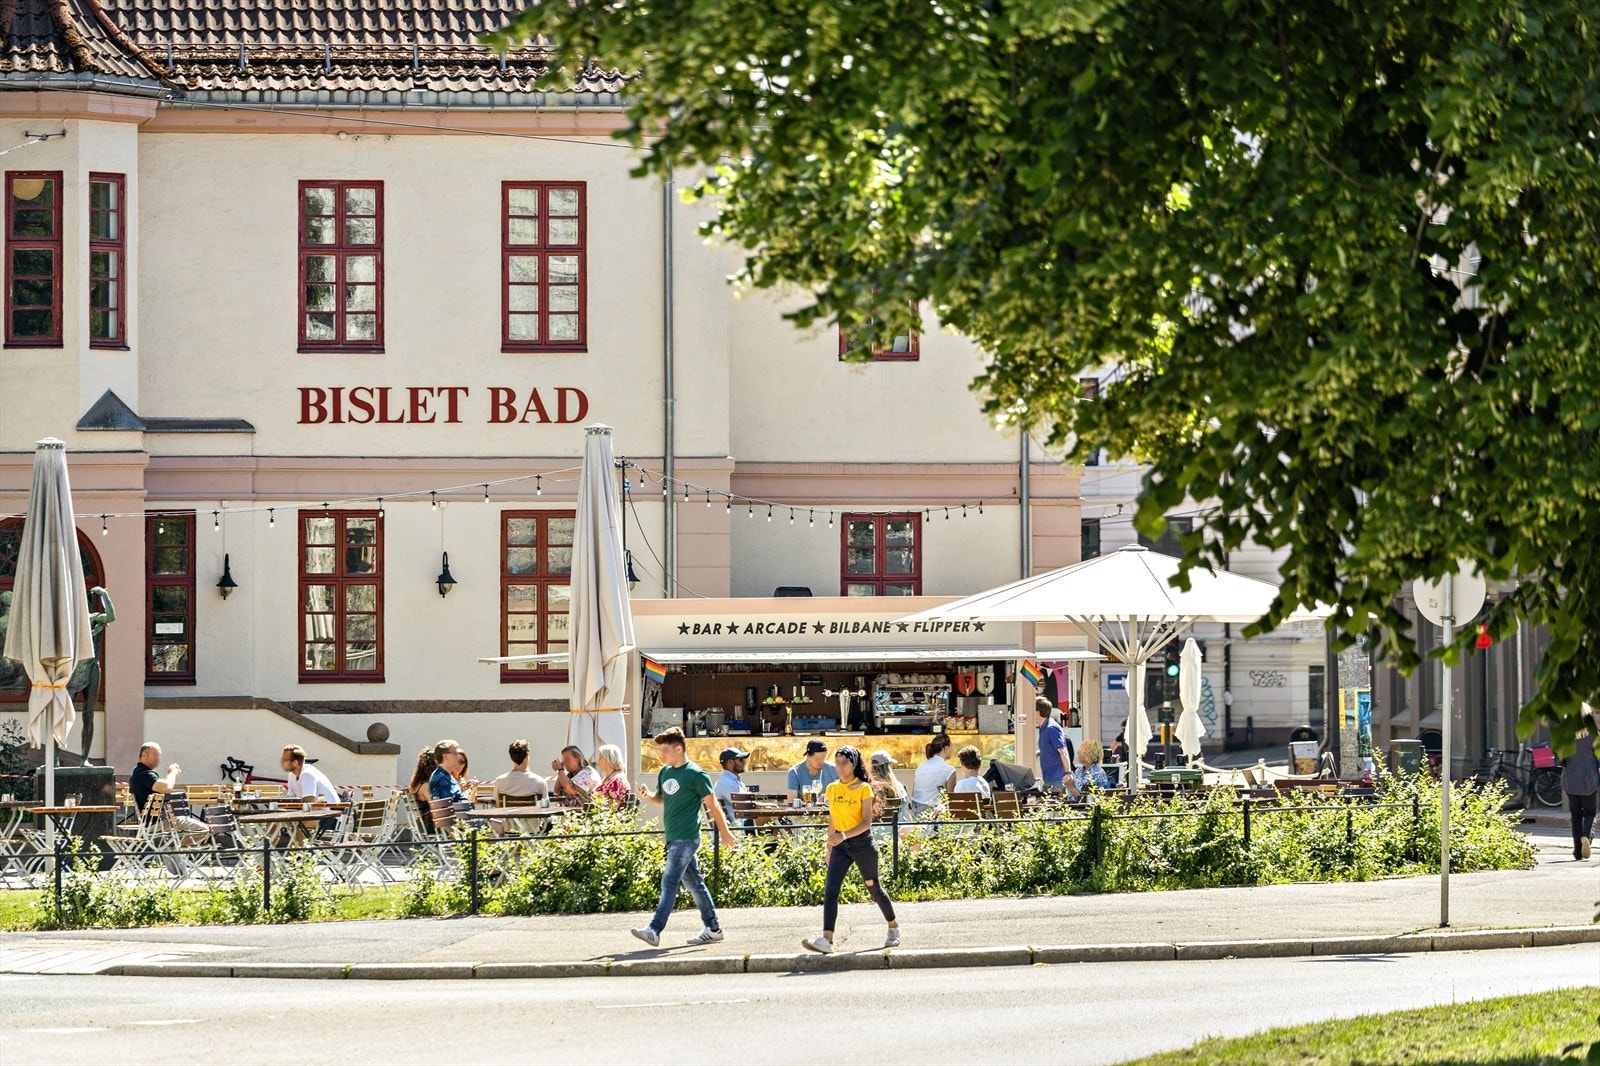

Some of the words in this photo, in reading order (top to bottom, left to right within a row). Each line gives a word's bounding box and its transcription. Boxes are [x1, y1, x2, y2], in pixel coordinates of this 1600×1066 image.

[296, 386, 469, 424] BISLET
[486, 386, 589, 424] BAD
[692, 623, 722, 635] BAR
[743, 622, 808, 634] ARCADE
[829, 621, 891, 634] BILBANE
[913, 621, 970, 633] FLIPPER
